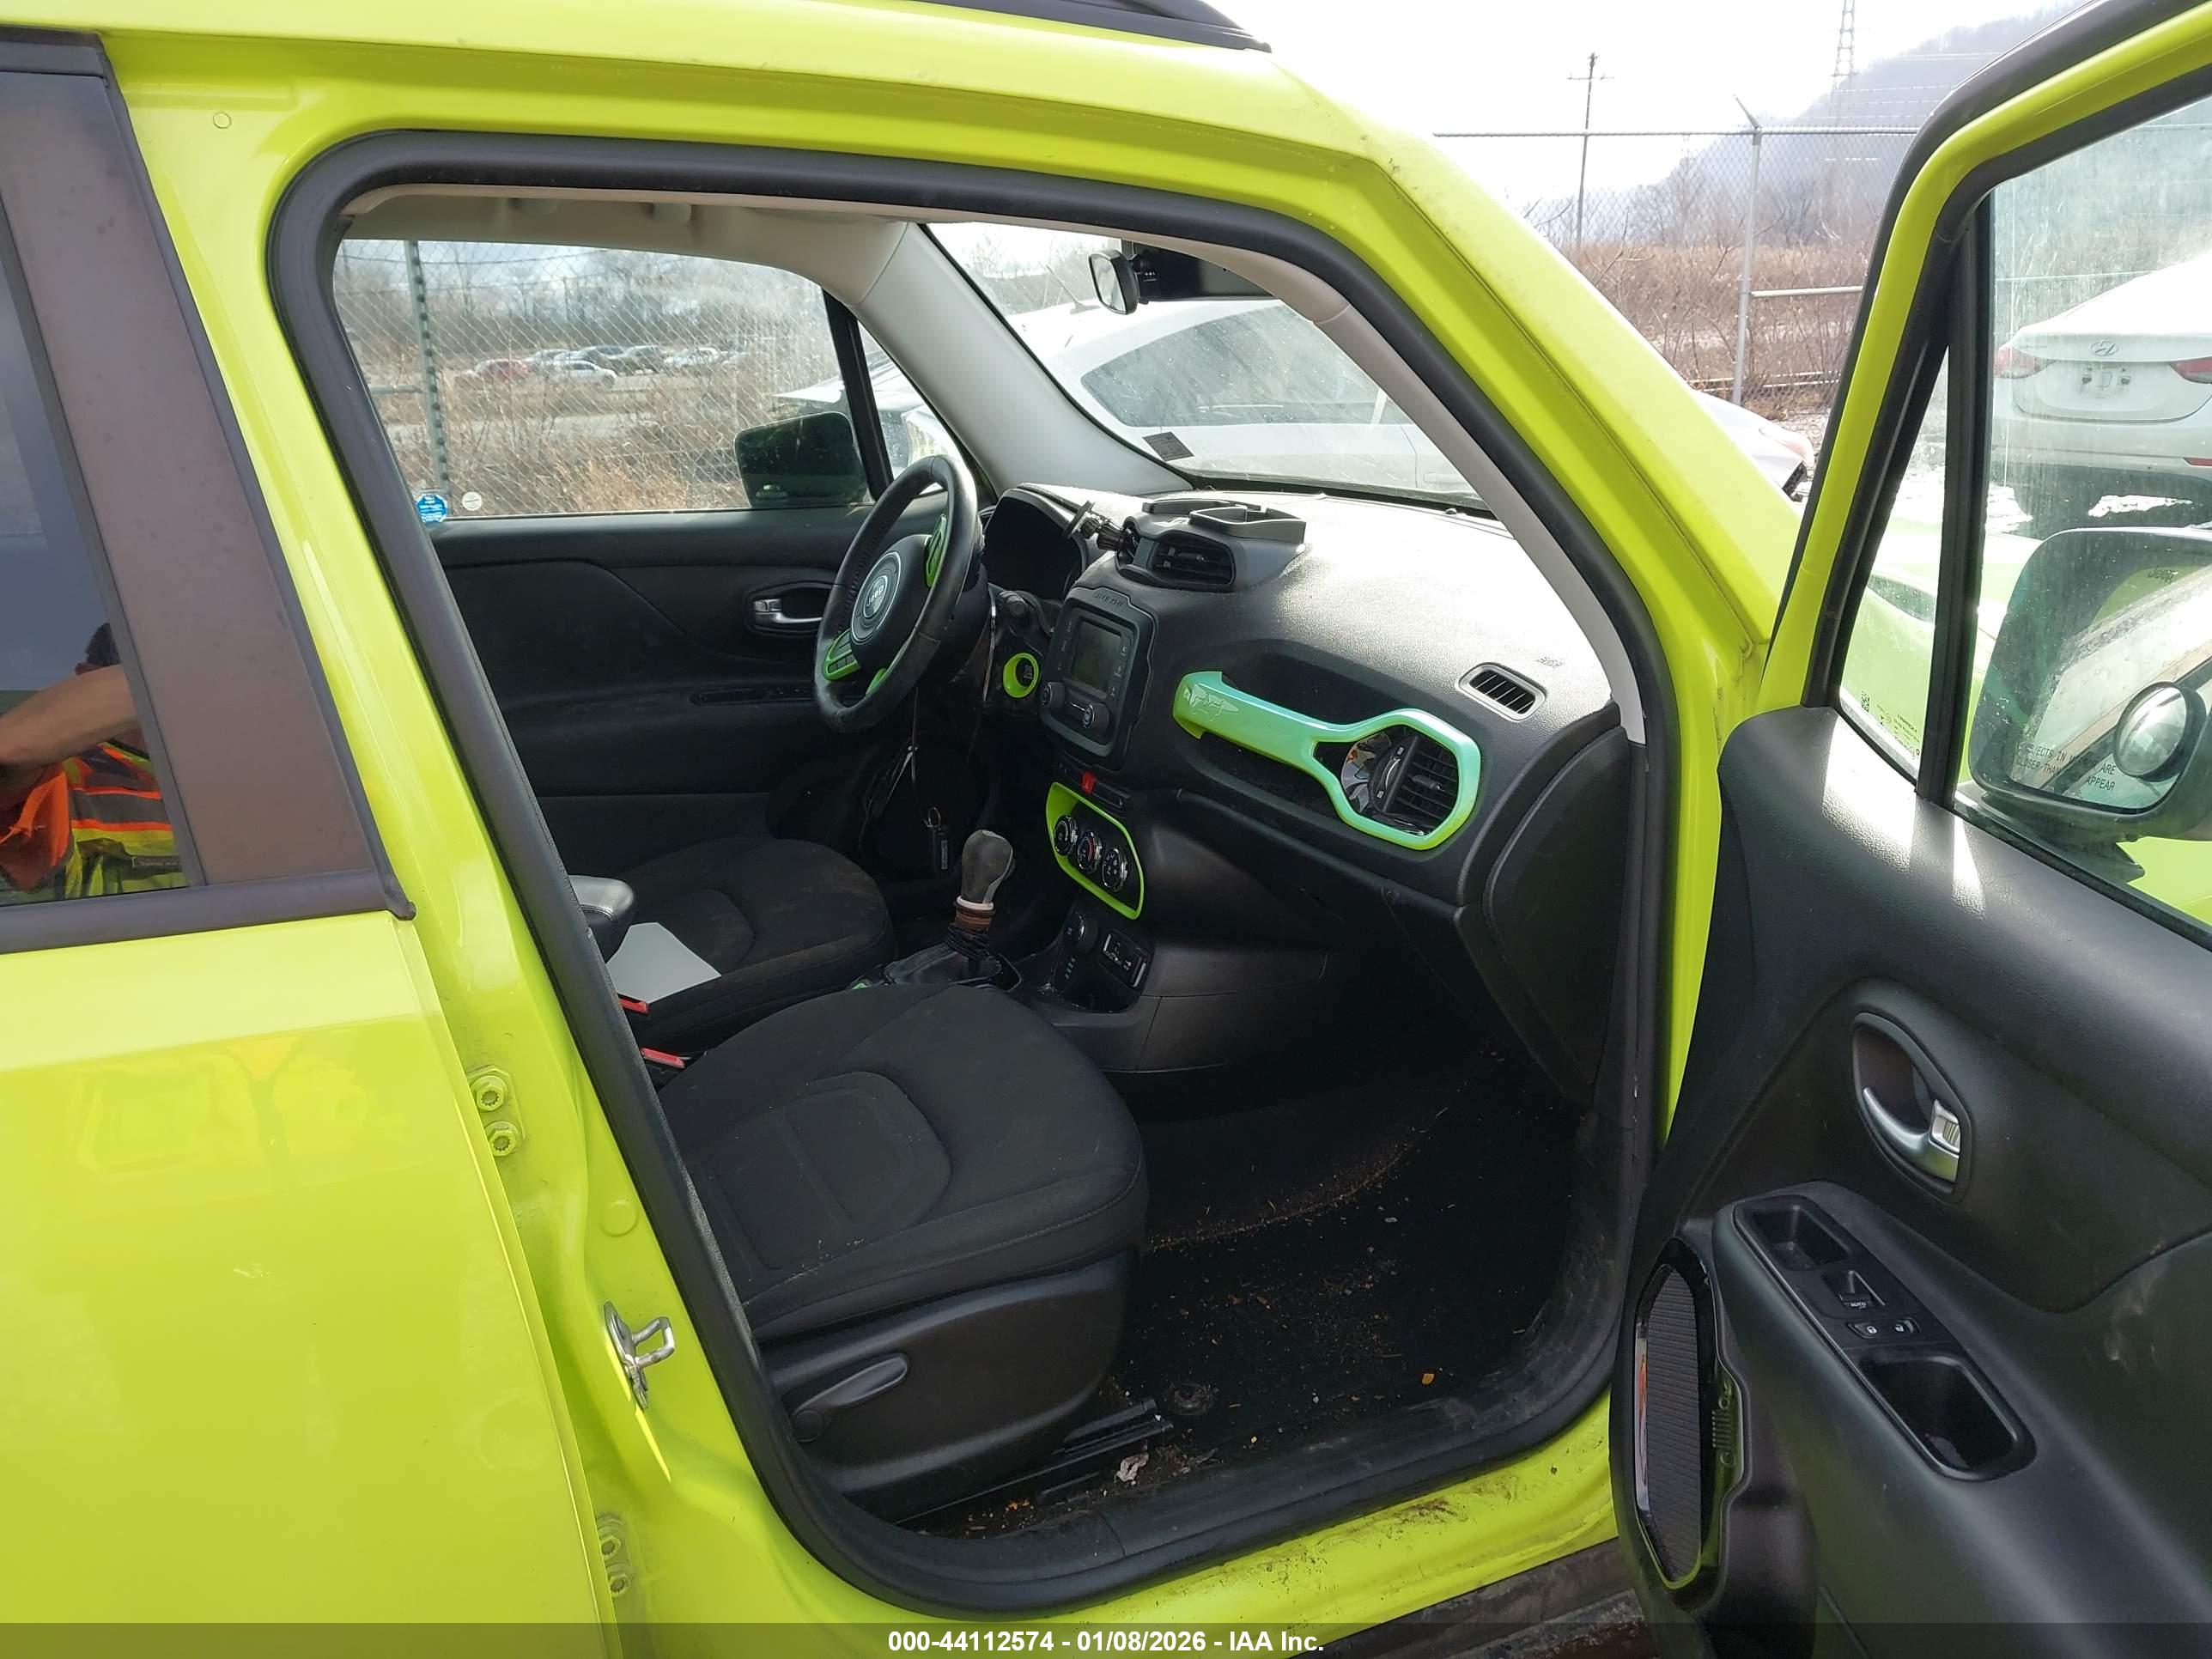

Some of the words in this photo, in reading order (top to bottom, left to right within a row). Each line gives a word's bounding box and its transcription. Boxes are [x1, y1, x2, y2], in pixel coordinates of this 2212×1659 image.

[866, 585, 884, 607] Jeep
[2056, 750, 2067, 763] IN
[2100, 763, 2117, 775] ARE
[2087, 776, 2116, 791] APPEAR
